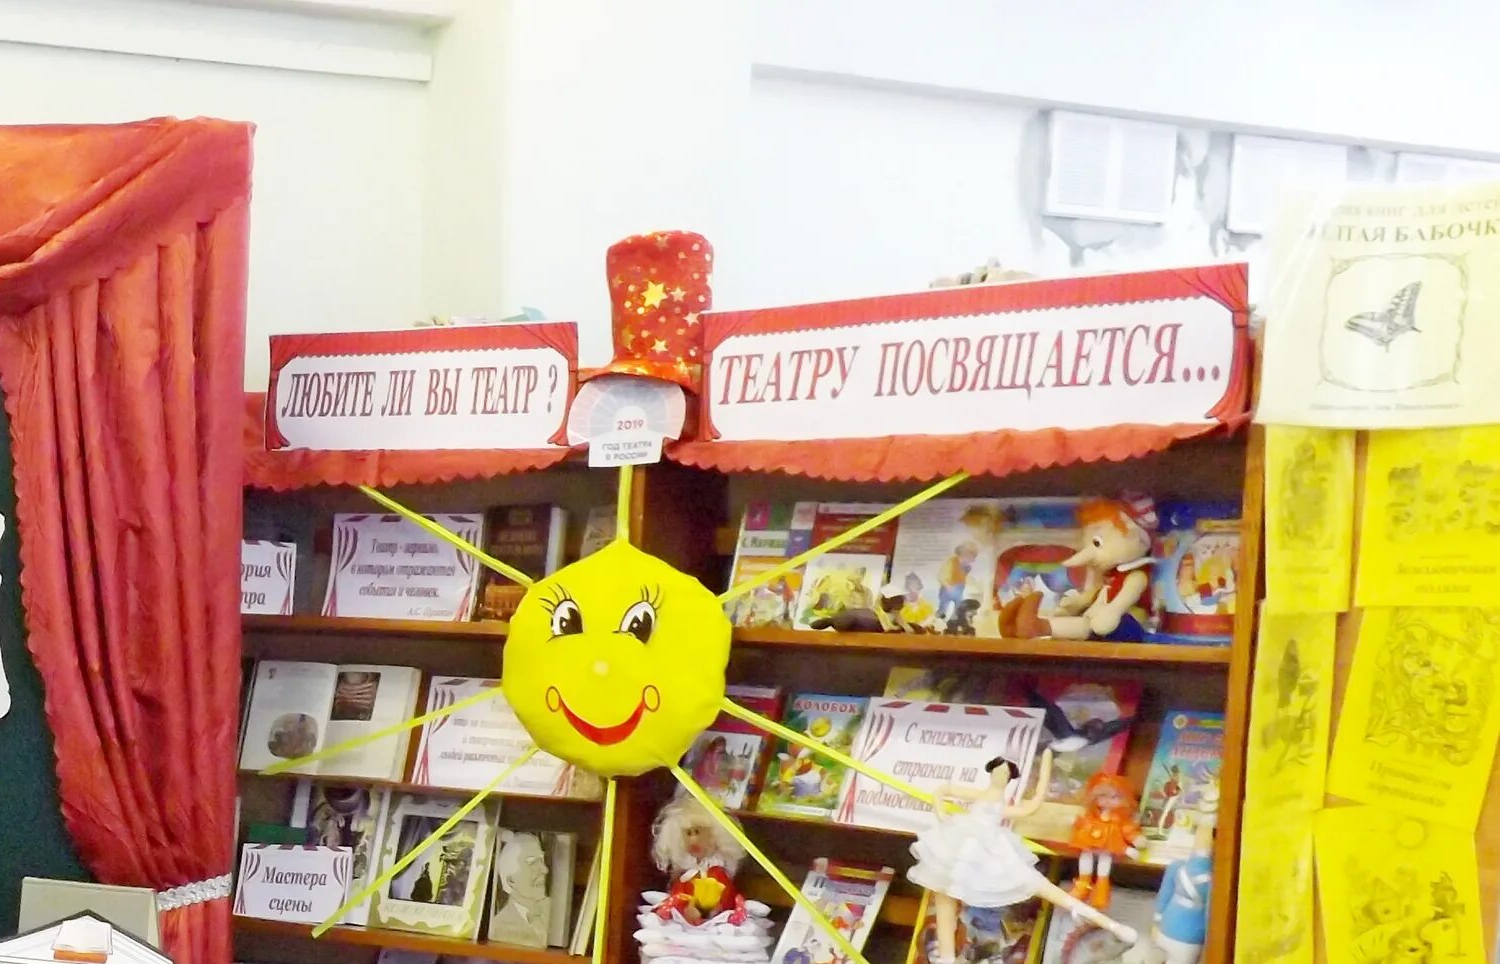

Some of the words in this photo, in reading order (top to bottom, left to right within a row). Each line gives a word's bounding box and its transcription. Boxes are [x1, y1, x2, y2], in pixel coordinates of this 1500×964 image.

[1394, 217, 1500, 244] БАБОЧК
[717, 345, 861, 405] ТЕАТРУ
[874, 322, 1221, 400] ПОСВЯЩАЕТСЯ...
[281, 371, 377, 419] ЛЮБИТЕ
[381, 369, 415, 418] ЛИ
[424, 367, 461, 416] ВЫ
[470, 364, 540, 416] ТЕАТР
[616, 418, 645, 431] 2019
[601, 442, 621, 452] ГОД
[622, 440, 653, 451] ТЕАТРА
[793, 698, 858, 714] КОЛОБОК
[904, 722, 918, 744] С
[919, 728, 988, 749] книжных
[892, 759, 956, 783] страниц
[958, 766, 979, 783] на
[260, 865, 328, 890] Мастера
[268, 897, 313, 914] сцены
